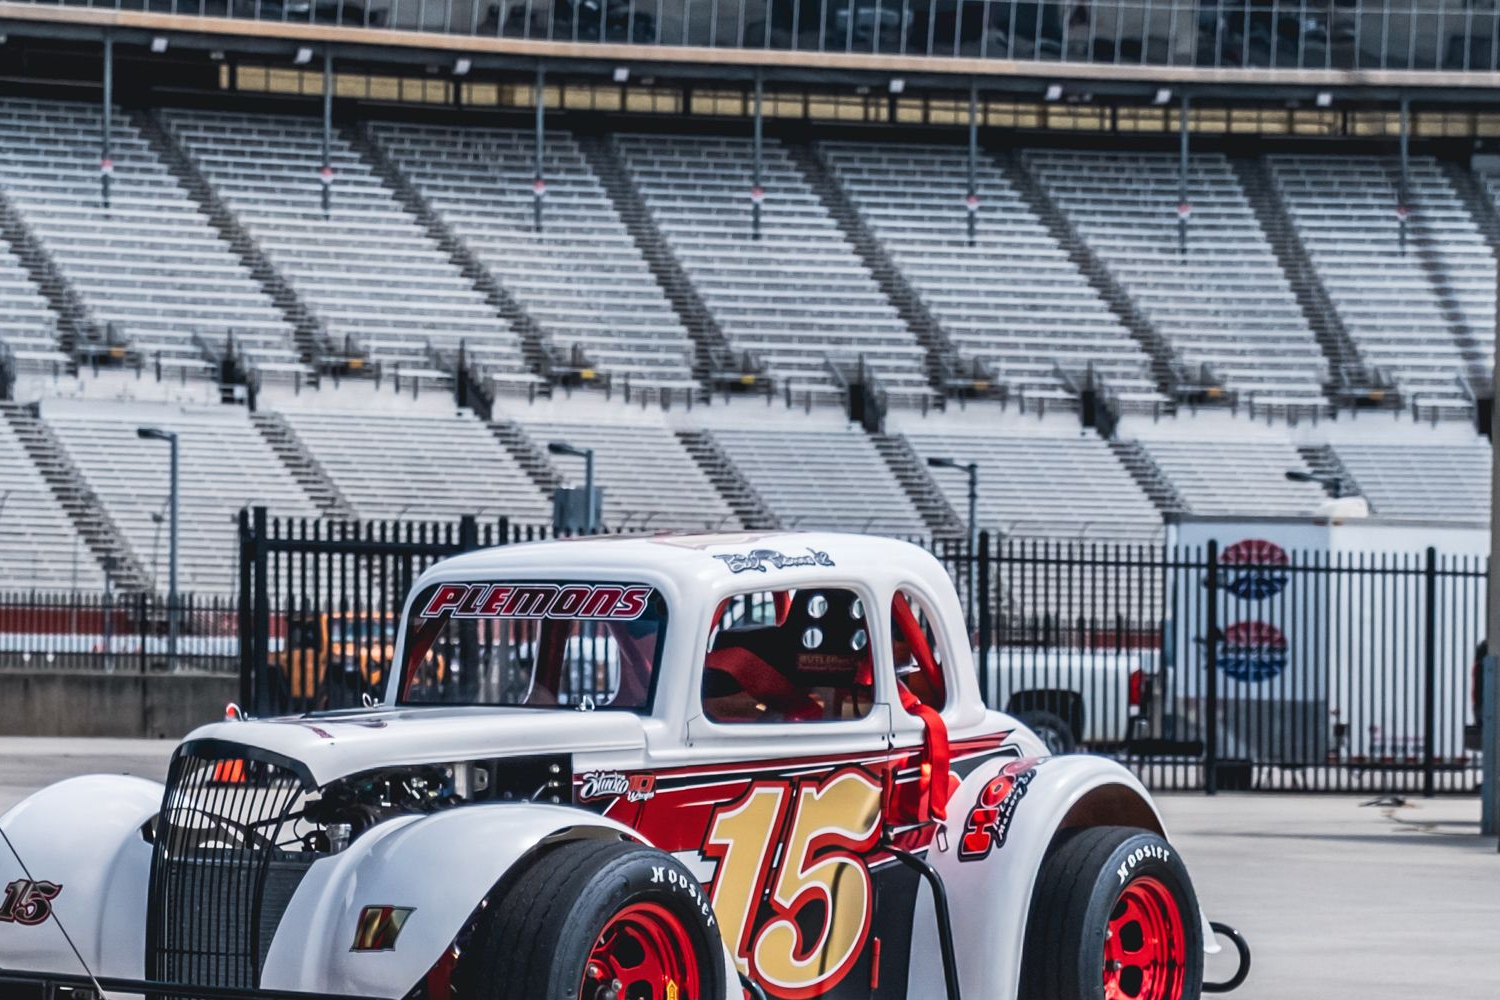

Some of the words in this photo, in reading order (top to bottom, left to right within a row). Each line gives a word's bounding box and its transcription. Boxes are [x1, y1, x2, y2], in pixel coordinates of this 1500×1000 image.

[421, 584, 653, 620] PLEMONS
[580, 772, 629, 799] Studio
[703, 767, 884, 996] 15
[1116, 844, 1170, 885] Hoosier
[650, 866, 715, 927] Hoosier
